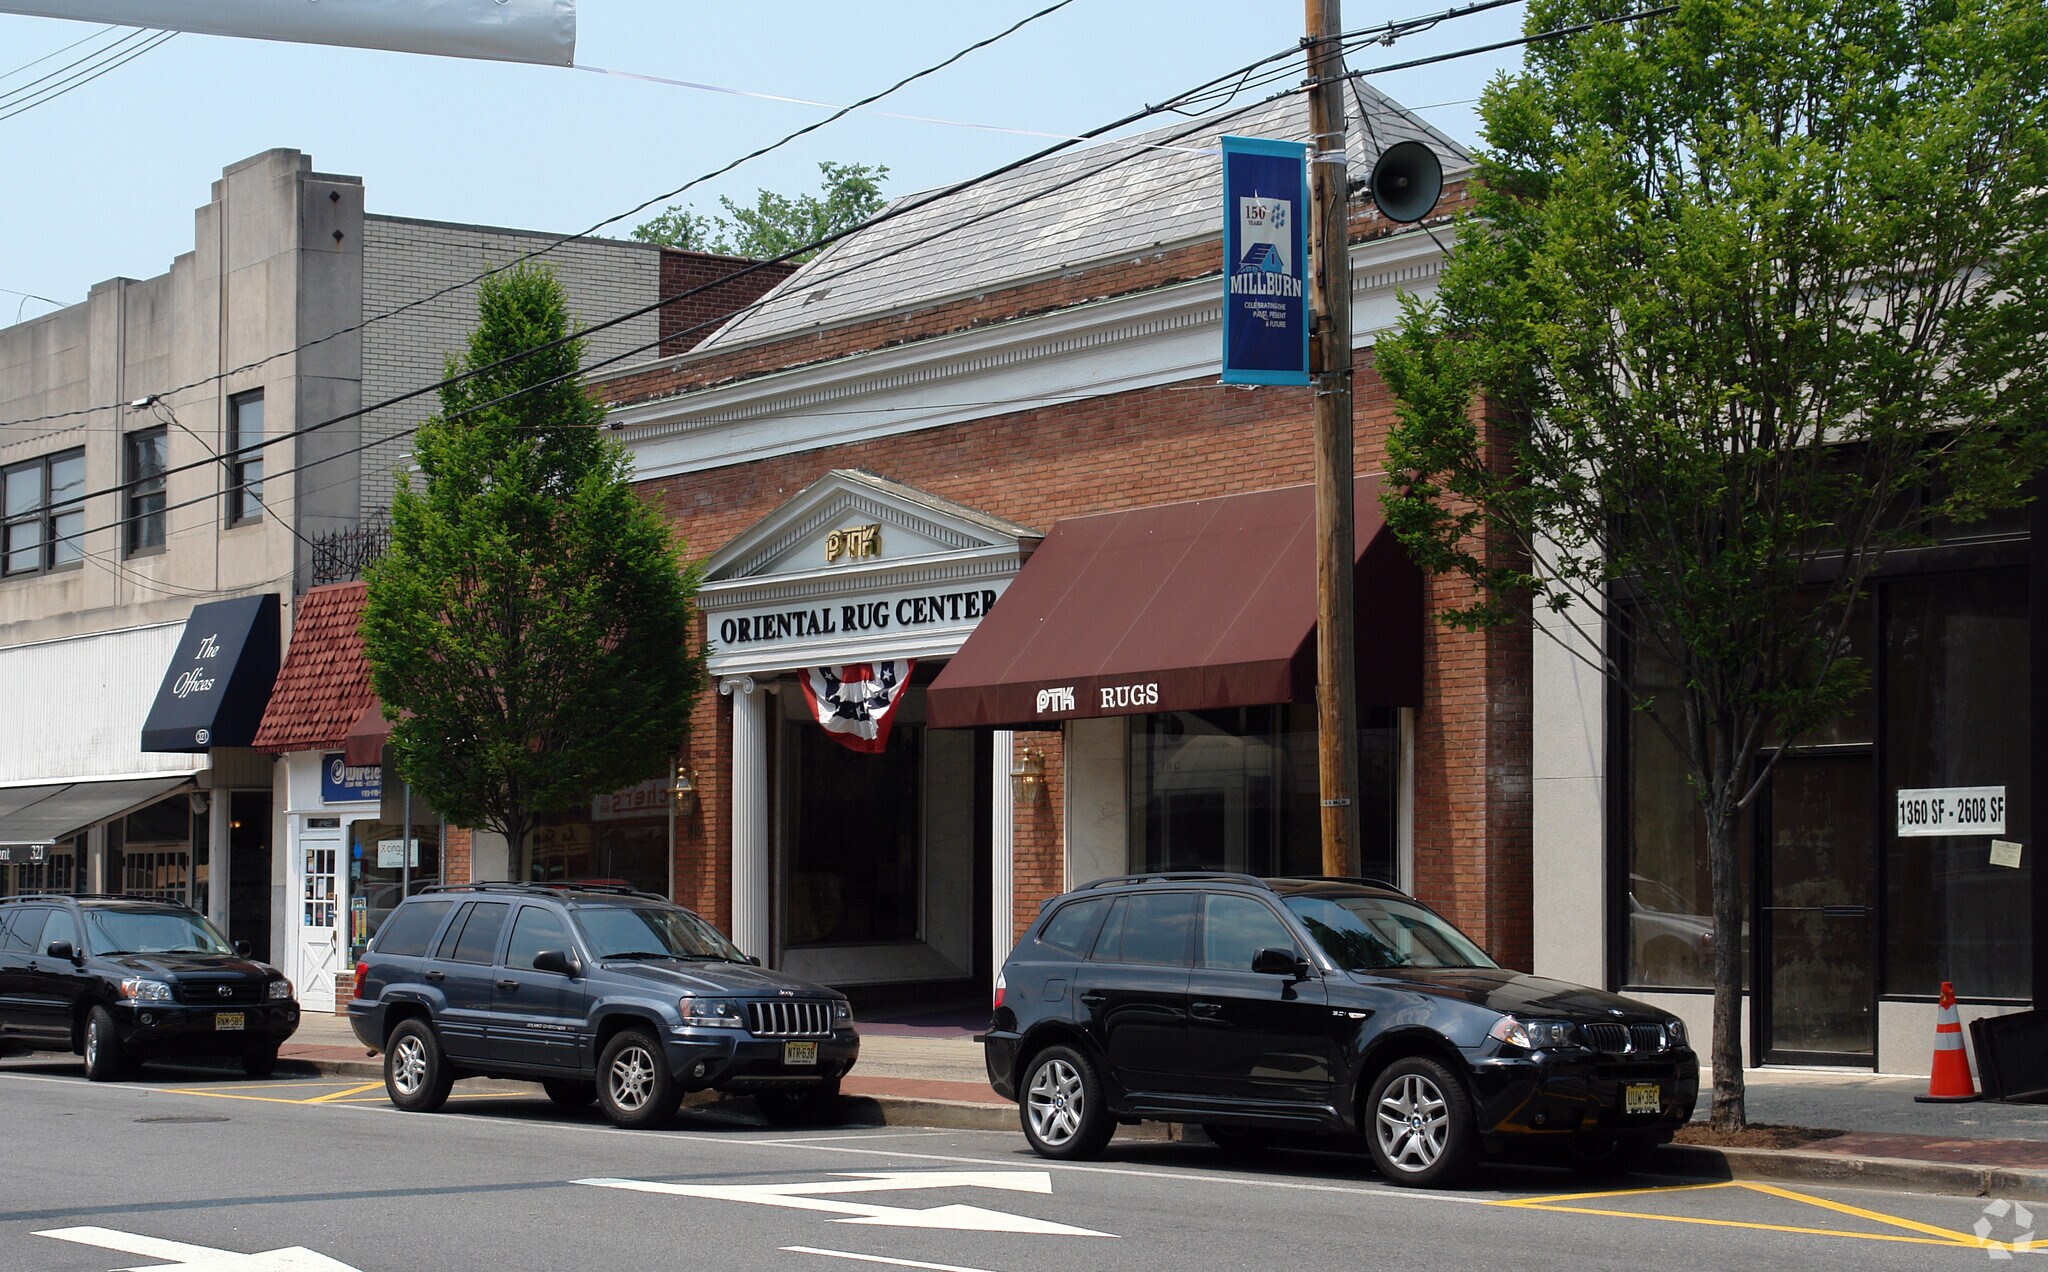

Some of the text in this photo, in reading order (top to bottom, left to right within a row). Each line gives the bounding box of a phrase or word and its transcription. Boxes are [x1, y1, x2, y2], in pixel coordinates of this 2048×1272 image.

[1246, 205, 1266, 219] 150
[1230, 272, 1302, 297] MILLBURN
[720, 589, 998, 644] ORIENTAL RUG CENTER
[195, 633, 220, 659] The
[173, 667, 215, 698] Offices
[1100, 683, 1159, 708] RUGS
[1900, 800, 1928, 824] 1360
[1931, 799, 1945, 824] SF
[1957, 798, 1986, 823] 2608
[1990, 797, 2004, 823] SF
[30, 845, 44, 860] 321
